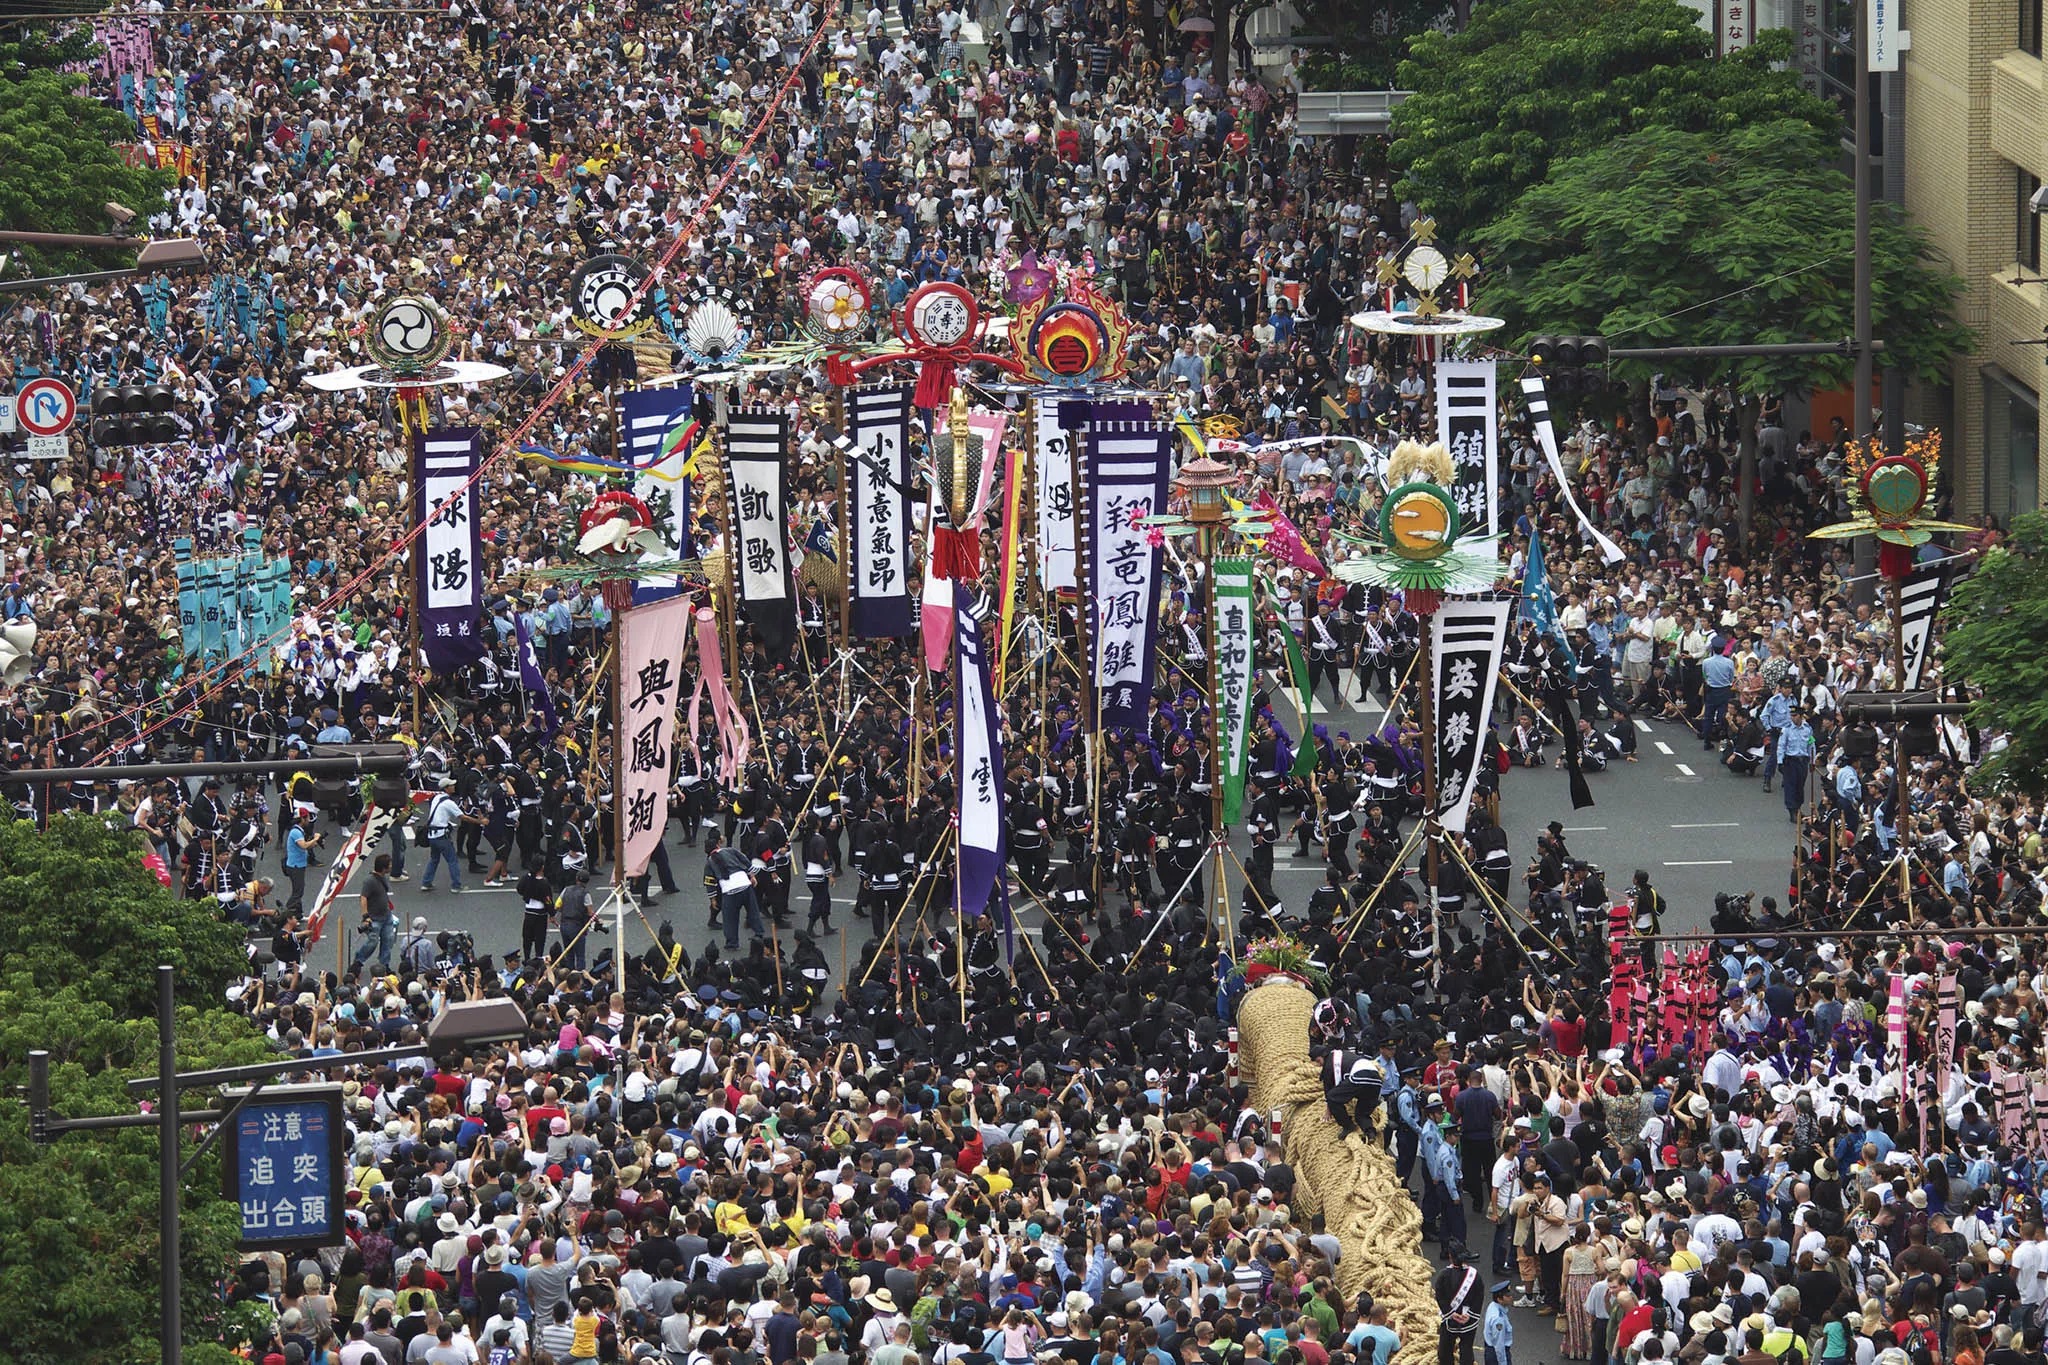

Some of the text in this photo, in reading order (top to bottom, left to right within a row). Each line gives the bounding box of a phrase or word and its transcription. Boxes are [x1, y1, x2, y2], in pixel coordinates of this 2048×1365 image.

[429, 490, 469, 592] 球陽
[740, 482, 778, 575] 凱歌
[263, 1111, 303, 1143] 注意
[249, 1152, 319, 1187] 追突
[242, 1195, 327, 1229] 出合頭
